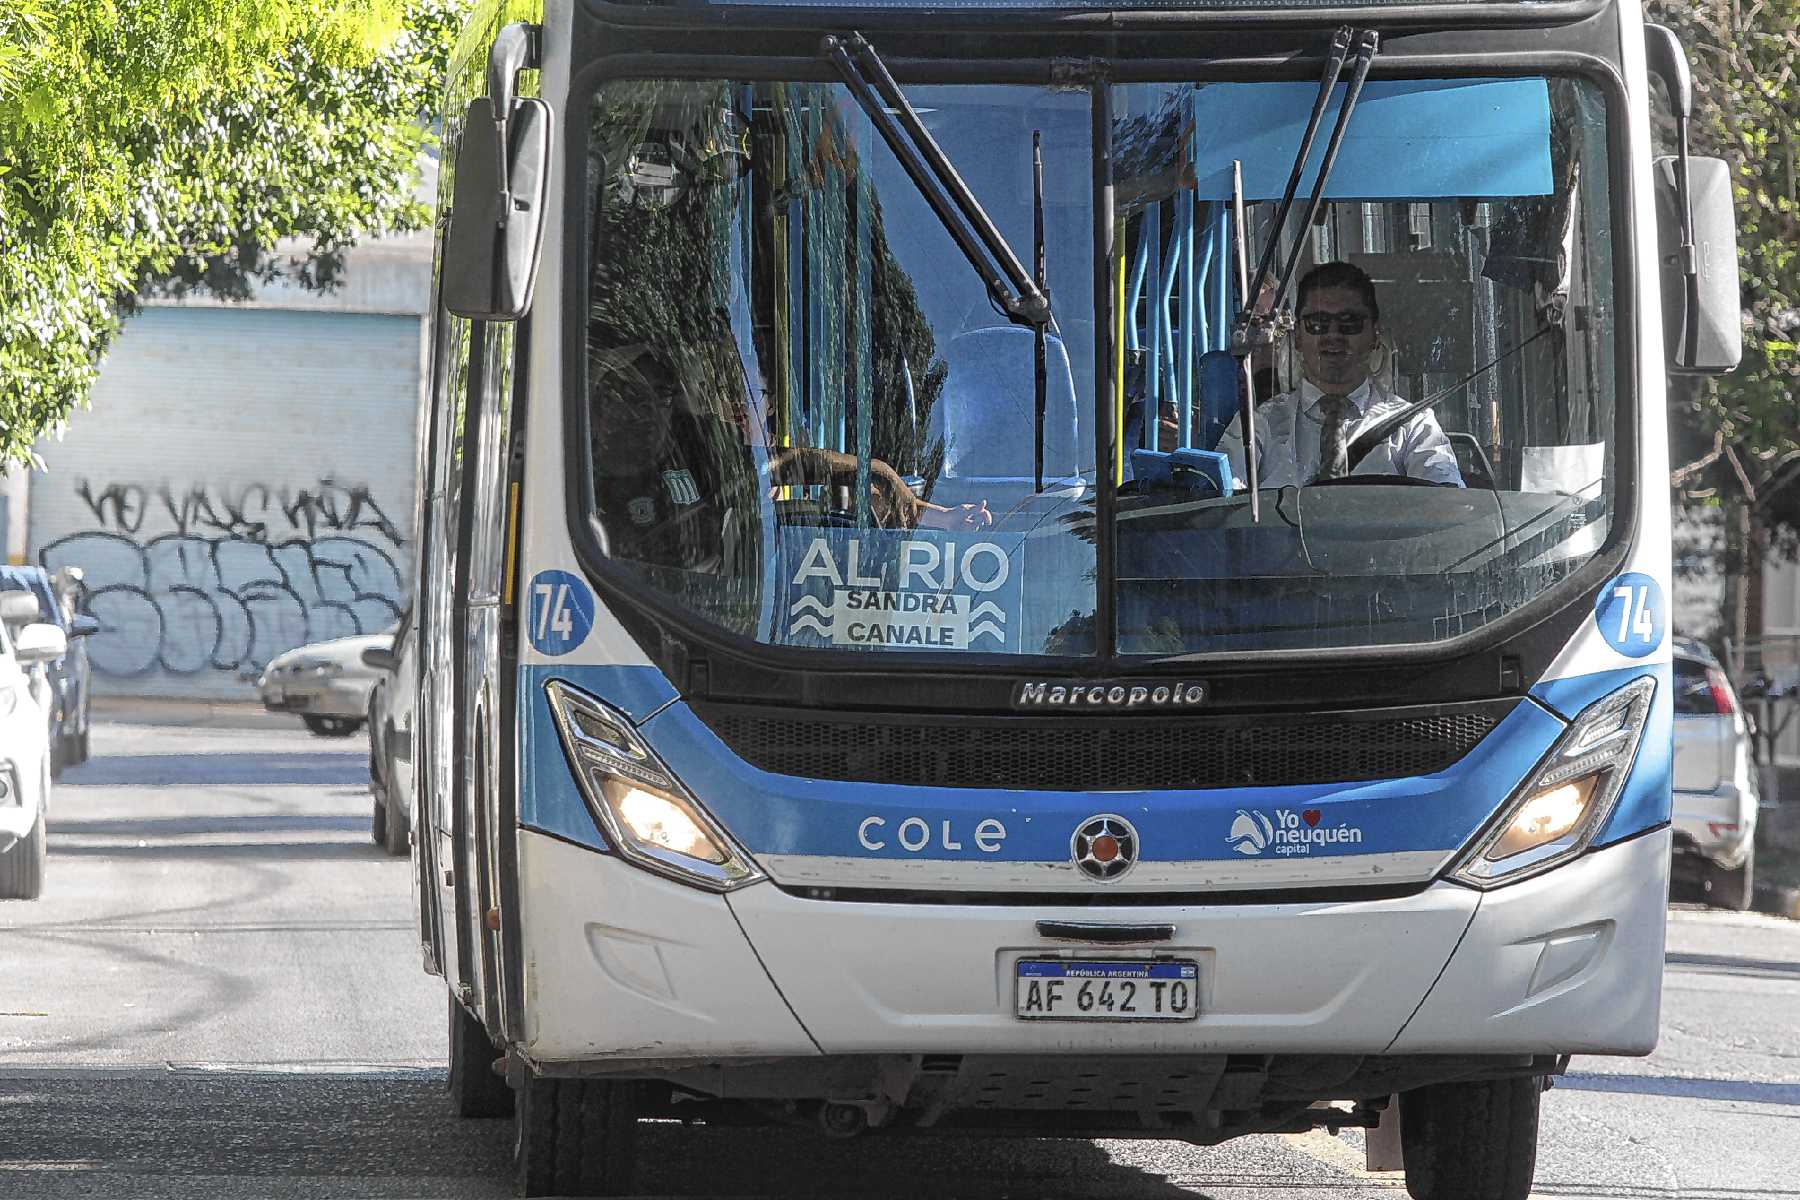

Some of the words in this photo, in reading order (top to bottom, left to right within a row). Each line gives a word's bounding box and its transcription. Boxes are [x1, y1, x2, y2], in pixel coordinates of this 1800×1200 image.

[792, 538, 881, 586] AL
[899, 540, 1009, 592] RIO
[535, 583, 573, 640] 74
[846, 591, 958, 614] SANDRA
[1613, 585, 1653, 643] 74
[847, 622, 954, 645] CANALE
[1019, 682, 1203, 706] Marcopolo
[1275, 809, 1299, 828] Yo
[1275, 823, 1362, 846] neuquén
[1275, 843, 1310, 856] capital
[1025, 980, 1065, 1011] AF
[1077, 980, 1136, 1012] 642
